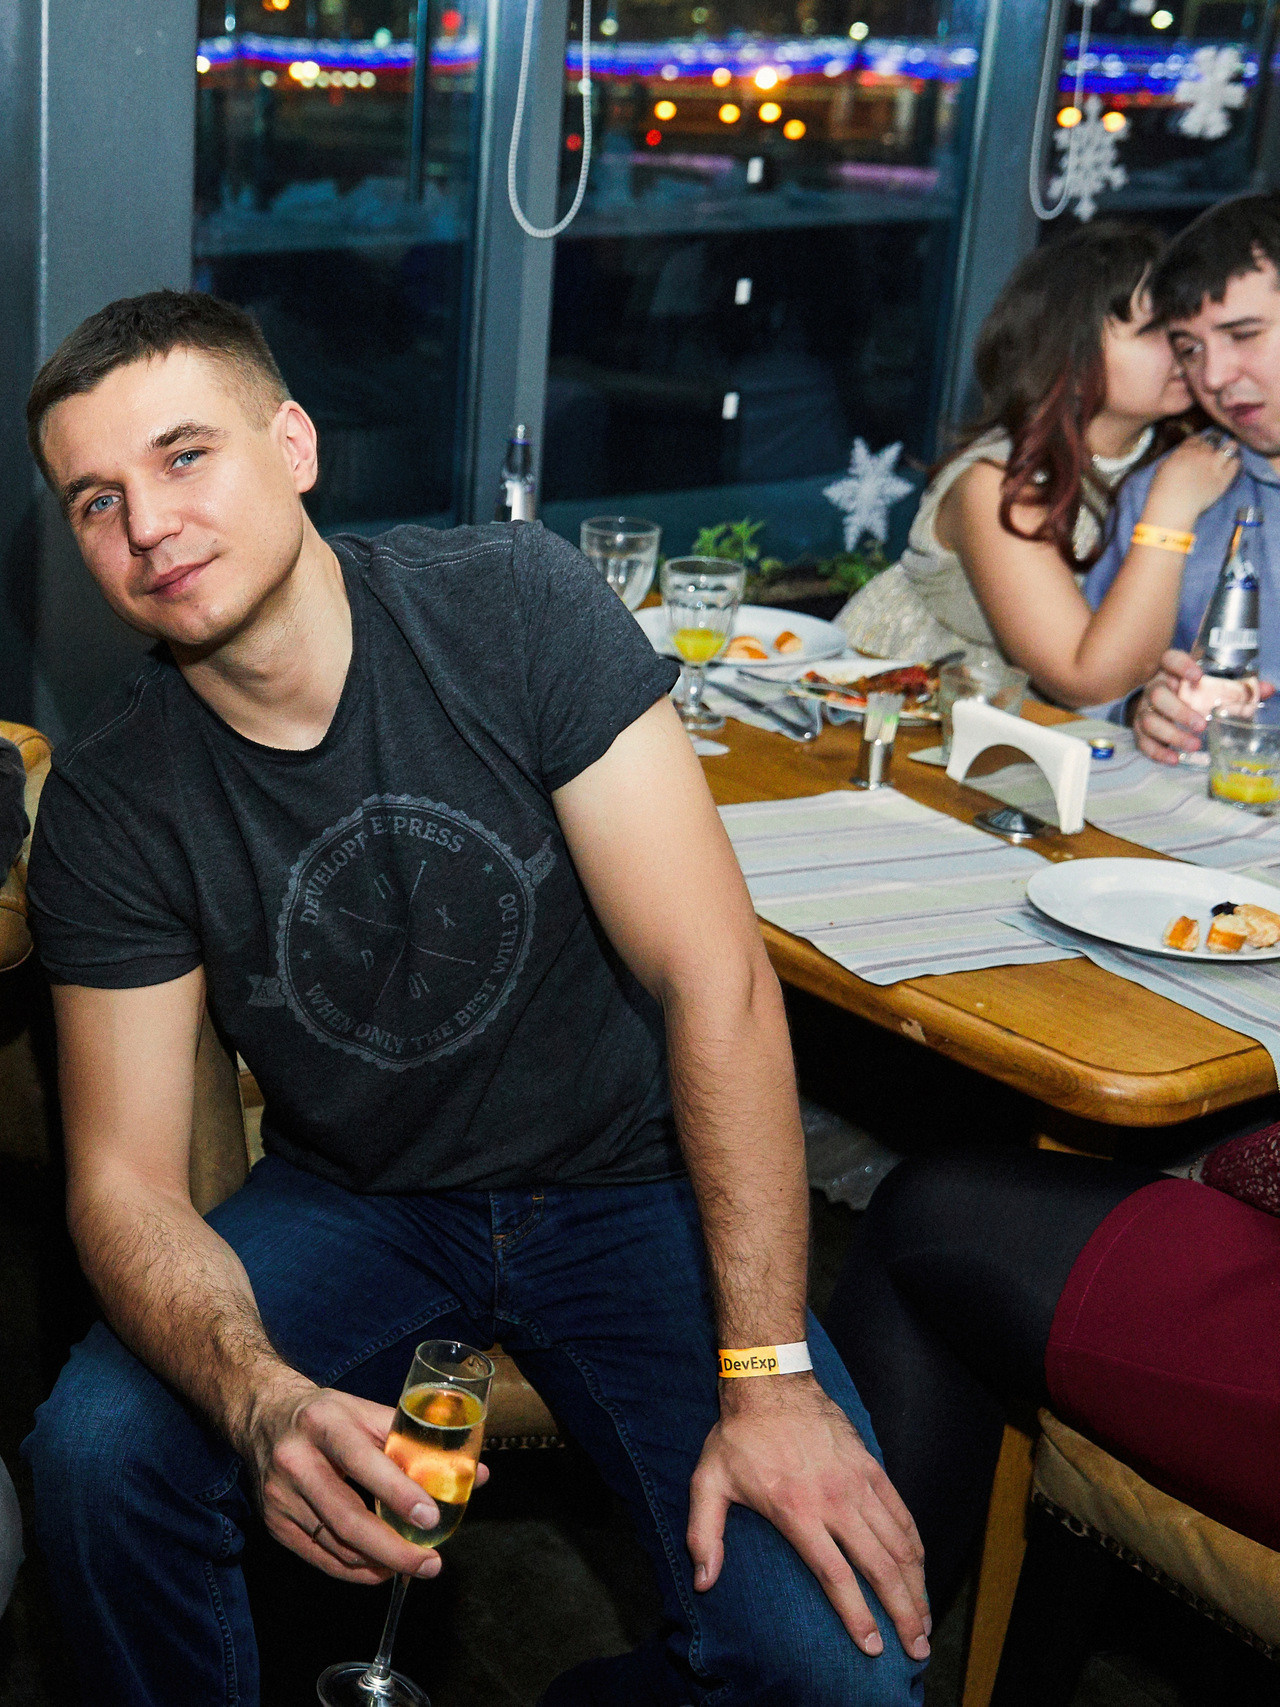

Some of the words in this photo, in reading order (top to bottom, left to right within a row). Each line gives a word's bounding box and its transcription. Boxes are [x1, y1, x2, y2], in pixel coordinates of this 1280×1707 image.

[369, 815, 466, 853] EPRESS
[498, 893, 520, 923] DO
[489, 924, 519, 975] WILL
[305, 982, 352, 1033] WHEN
[453, 978, 497, 1027] BEST
[353, 1022, 404, 1054] ONLY
[410, 1021, 454, 1051] THE
[723, 1356, 779, 1372] DevExp
